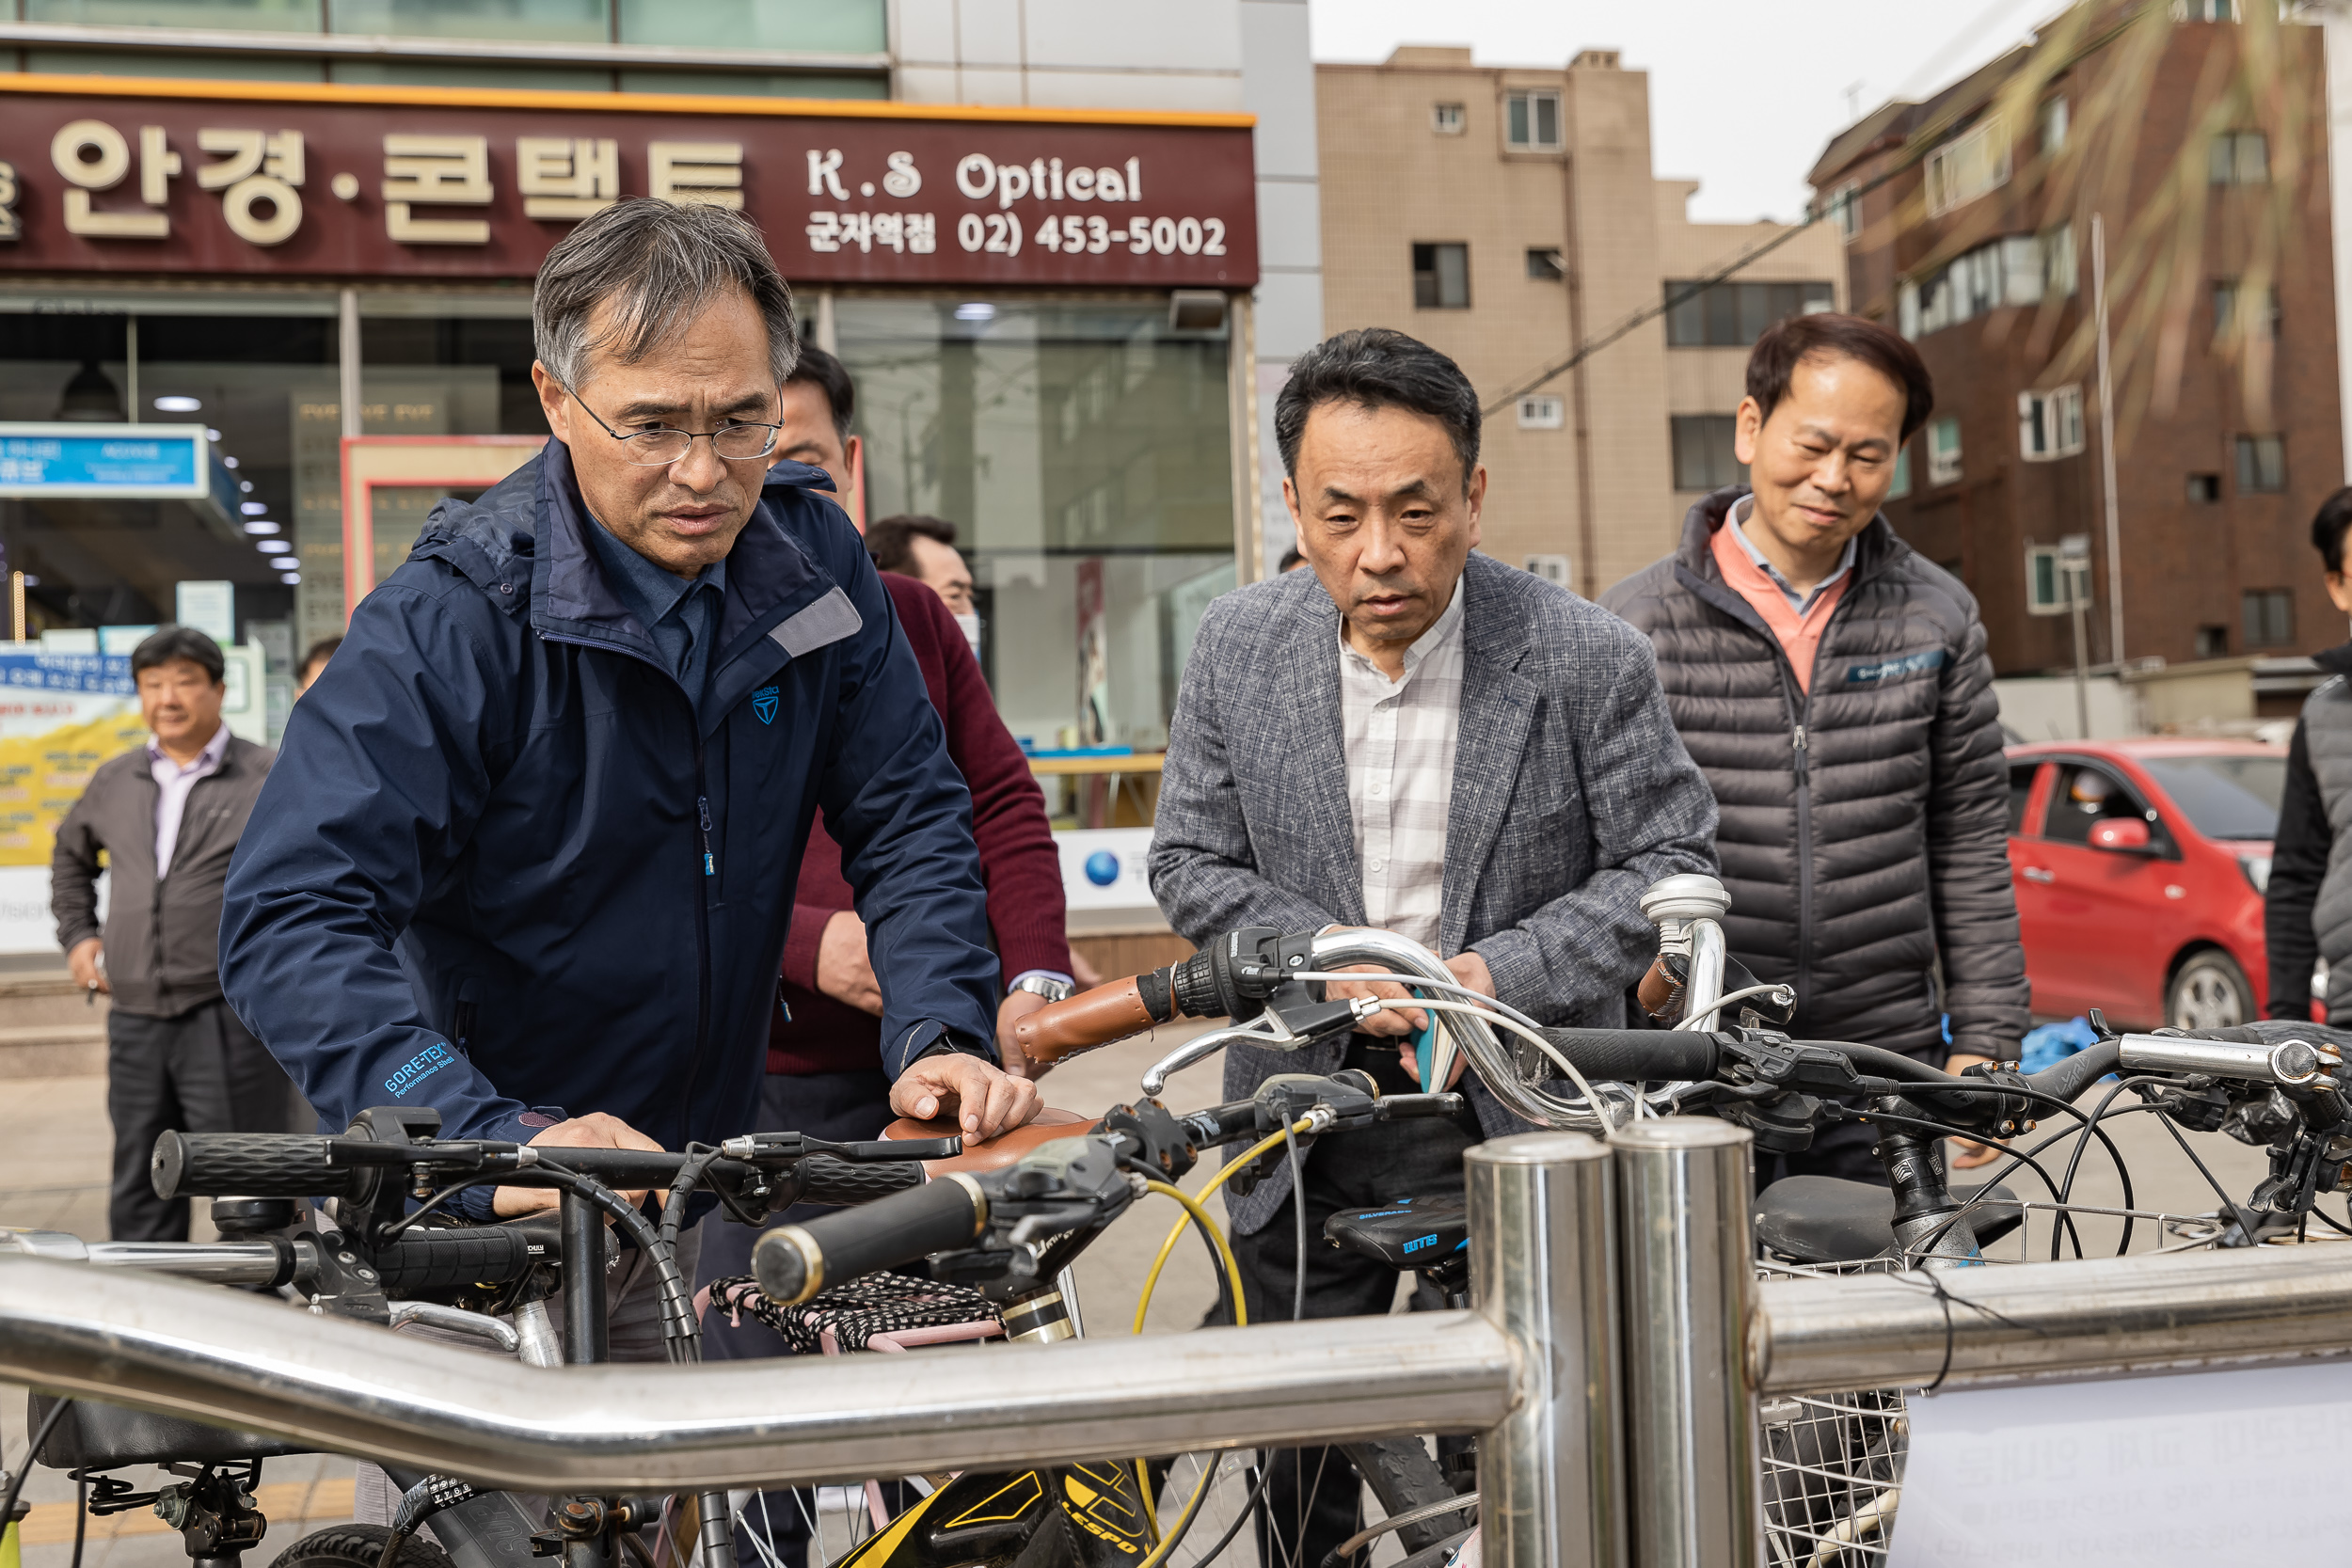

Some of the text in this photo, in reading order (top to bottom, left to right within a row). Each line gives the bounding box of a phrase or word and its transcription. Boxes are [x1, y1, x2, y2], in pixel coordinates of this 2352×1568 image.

[955, 152, 1142, 210] Optical
[804, 211, 1228, 258] 군자역점 02) 453-5002
[395, 1055, 455, 1099] Performance Shell
[1403, 1233, 1438, 1254] WTB
[1061, 1501, 1138, 1554] LESPO
